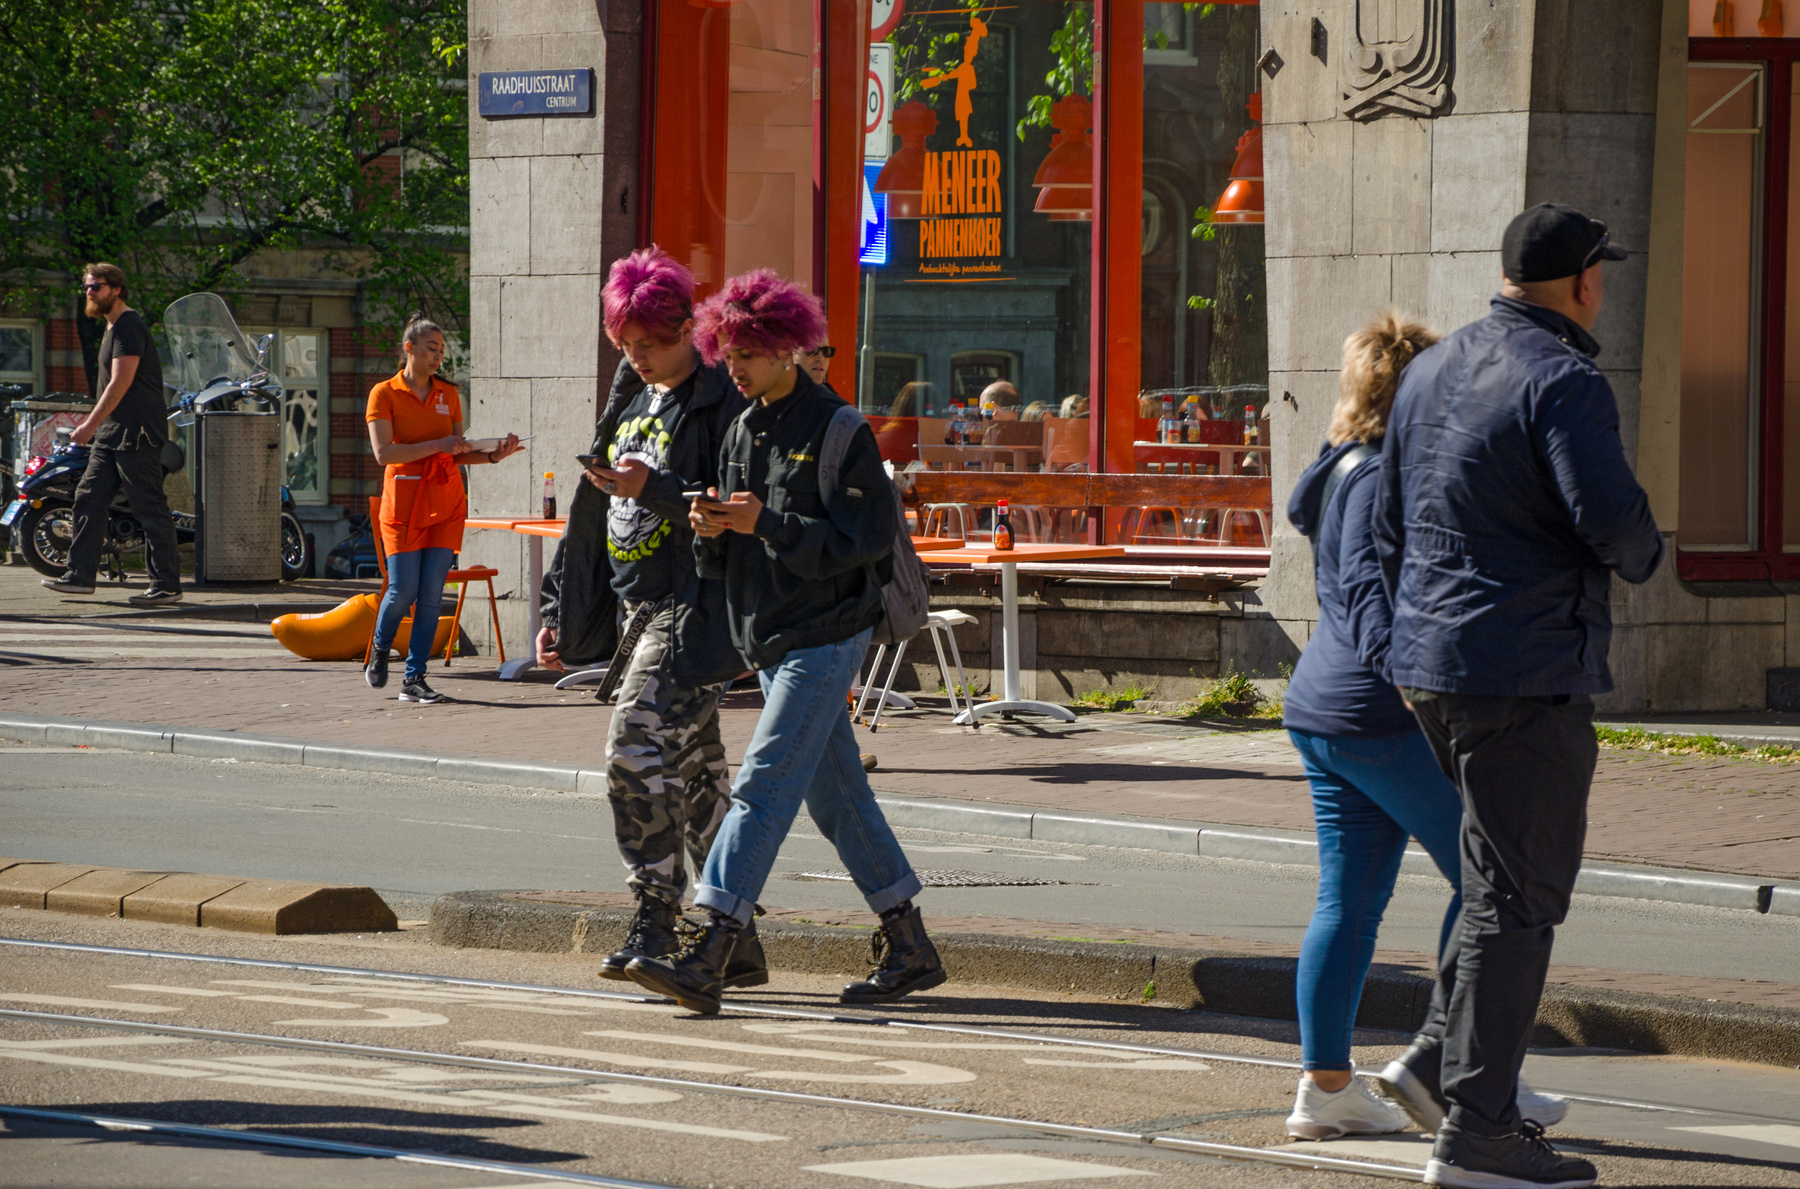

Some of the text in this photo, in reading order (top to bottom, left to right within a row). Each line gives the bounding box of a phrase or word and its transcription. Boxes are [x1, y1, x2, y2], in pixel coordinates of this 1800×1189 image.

[492, 75, 576, 95] RAADHUISSTRAAT
[546, 96, 577, 108] CENTRUM
[868, 90, 878, 113] 0
[920, 149, 1002, 215] MENEER
[919, 217, 1002, 258] PANNENKOEK
